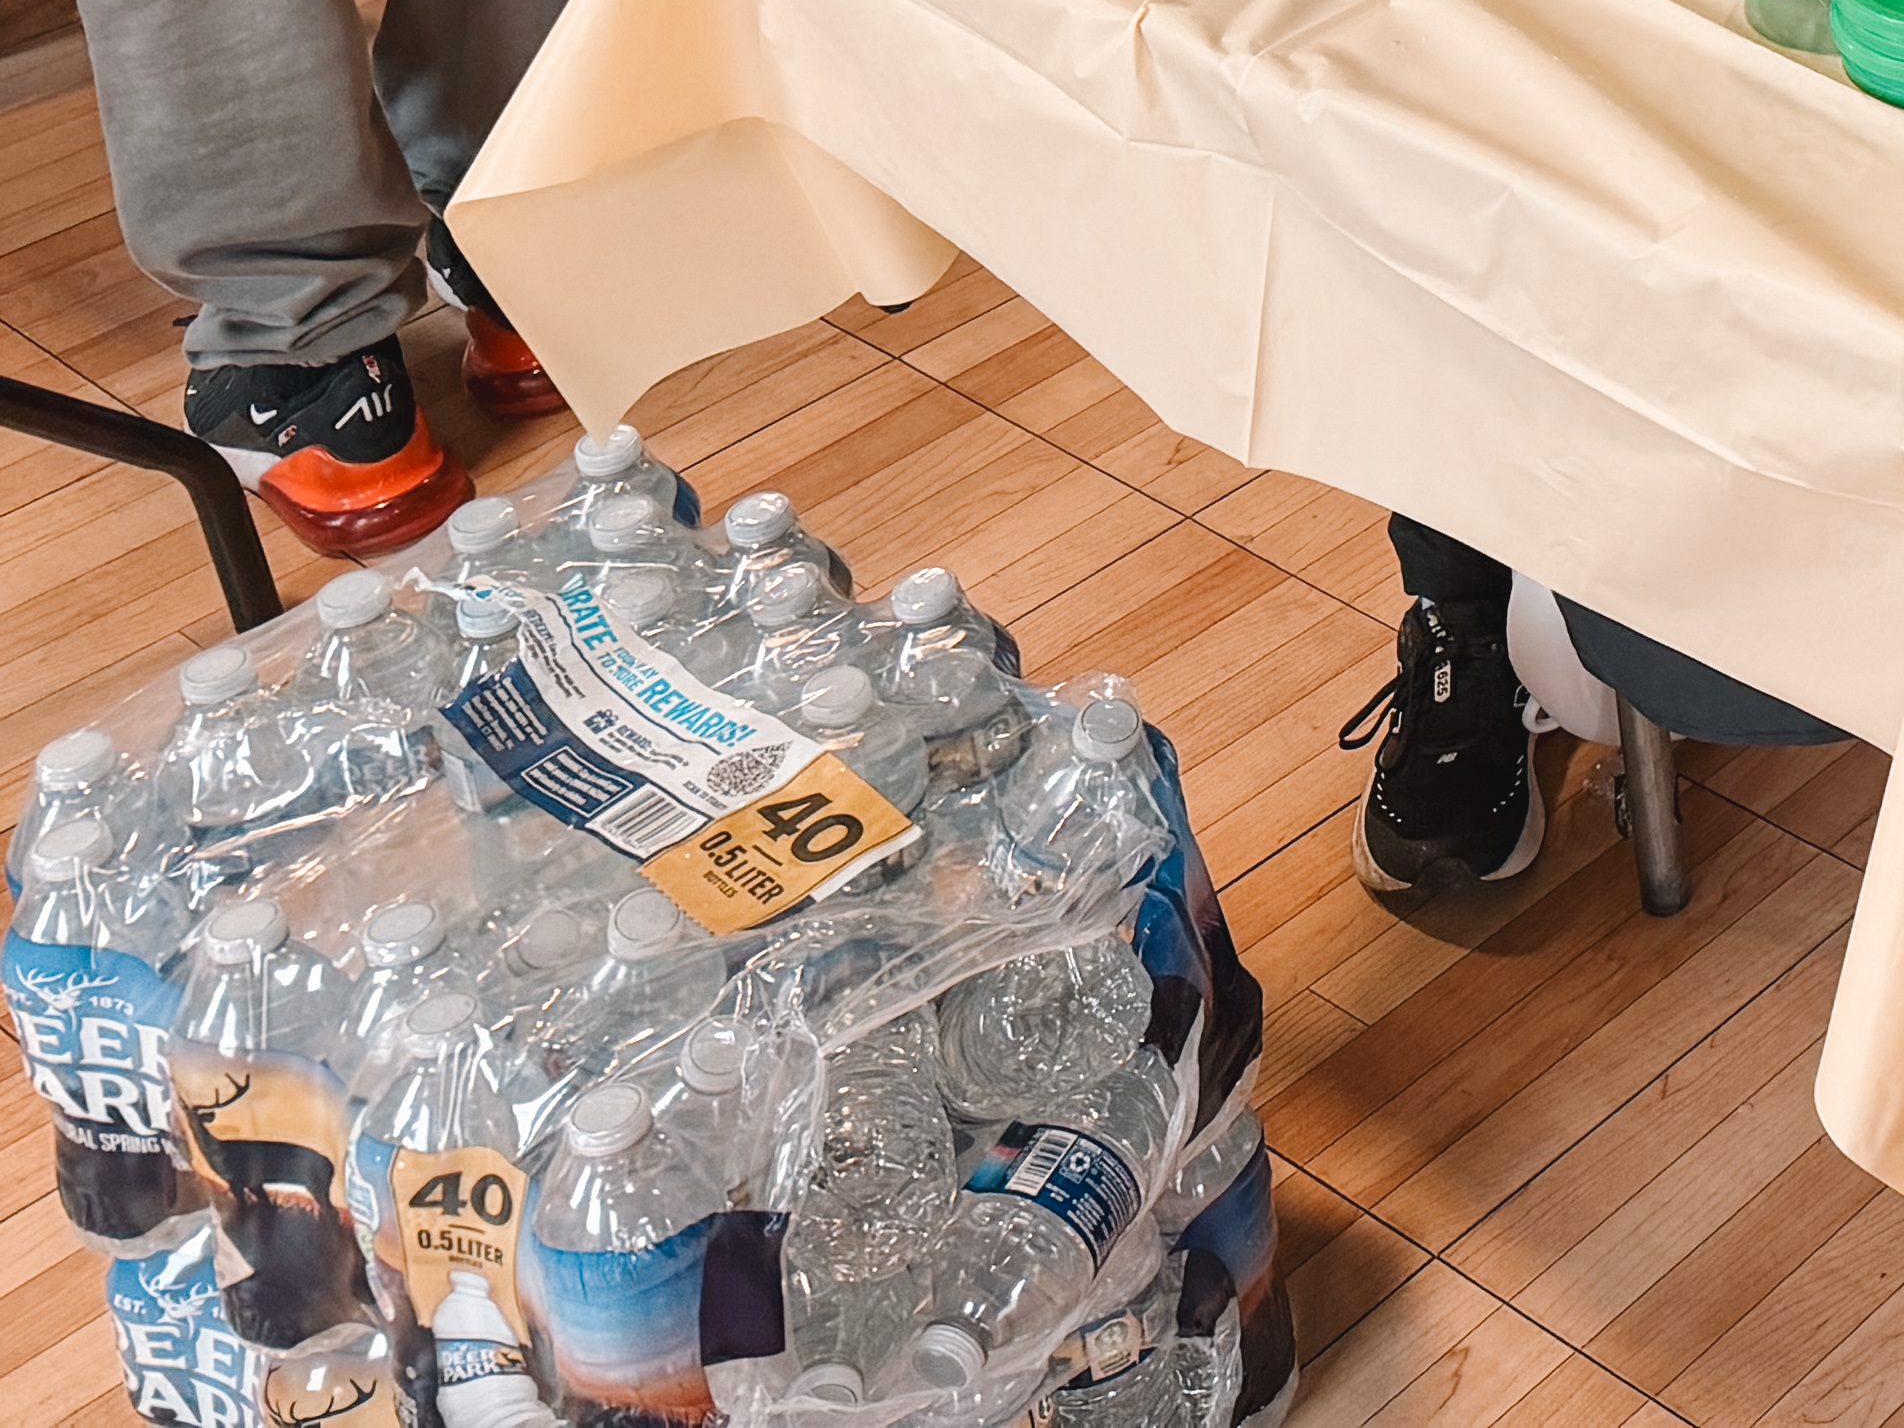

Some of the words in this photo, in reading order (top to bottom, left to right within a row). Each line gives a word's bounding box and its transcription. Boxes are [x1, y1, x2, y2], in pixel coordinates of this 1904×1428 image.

[637, 677, 758, 748] REWARDS!
[757, 792, 864, 863] 40
[699, 830, 747, 868] 0.5
[725, 855, 785, 905] LITER
[89, 994, 135, 1017] 1873
[98, 1133, 161, 1154] SPRING
[408, 1170, 513, 1227] 40
[417, 1228, 454, 1251] 0.5
[457, 1235, 504, 1267] LITER
[113, 1294, 148, 1315] EST.
[441, 1347, 496, 1366] DEER
[443, 1360, 501, 1384] PARK
